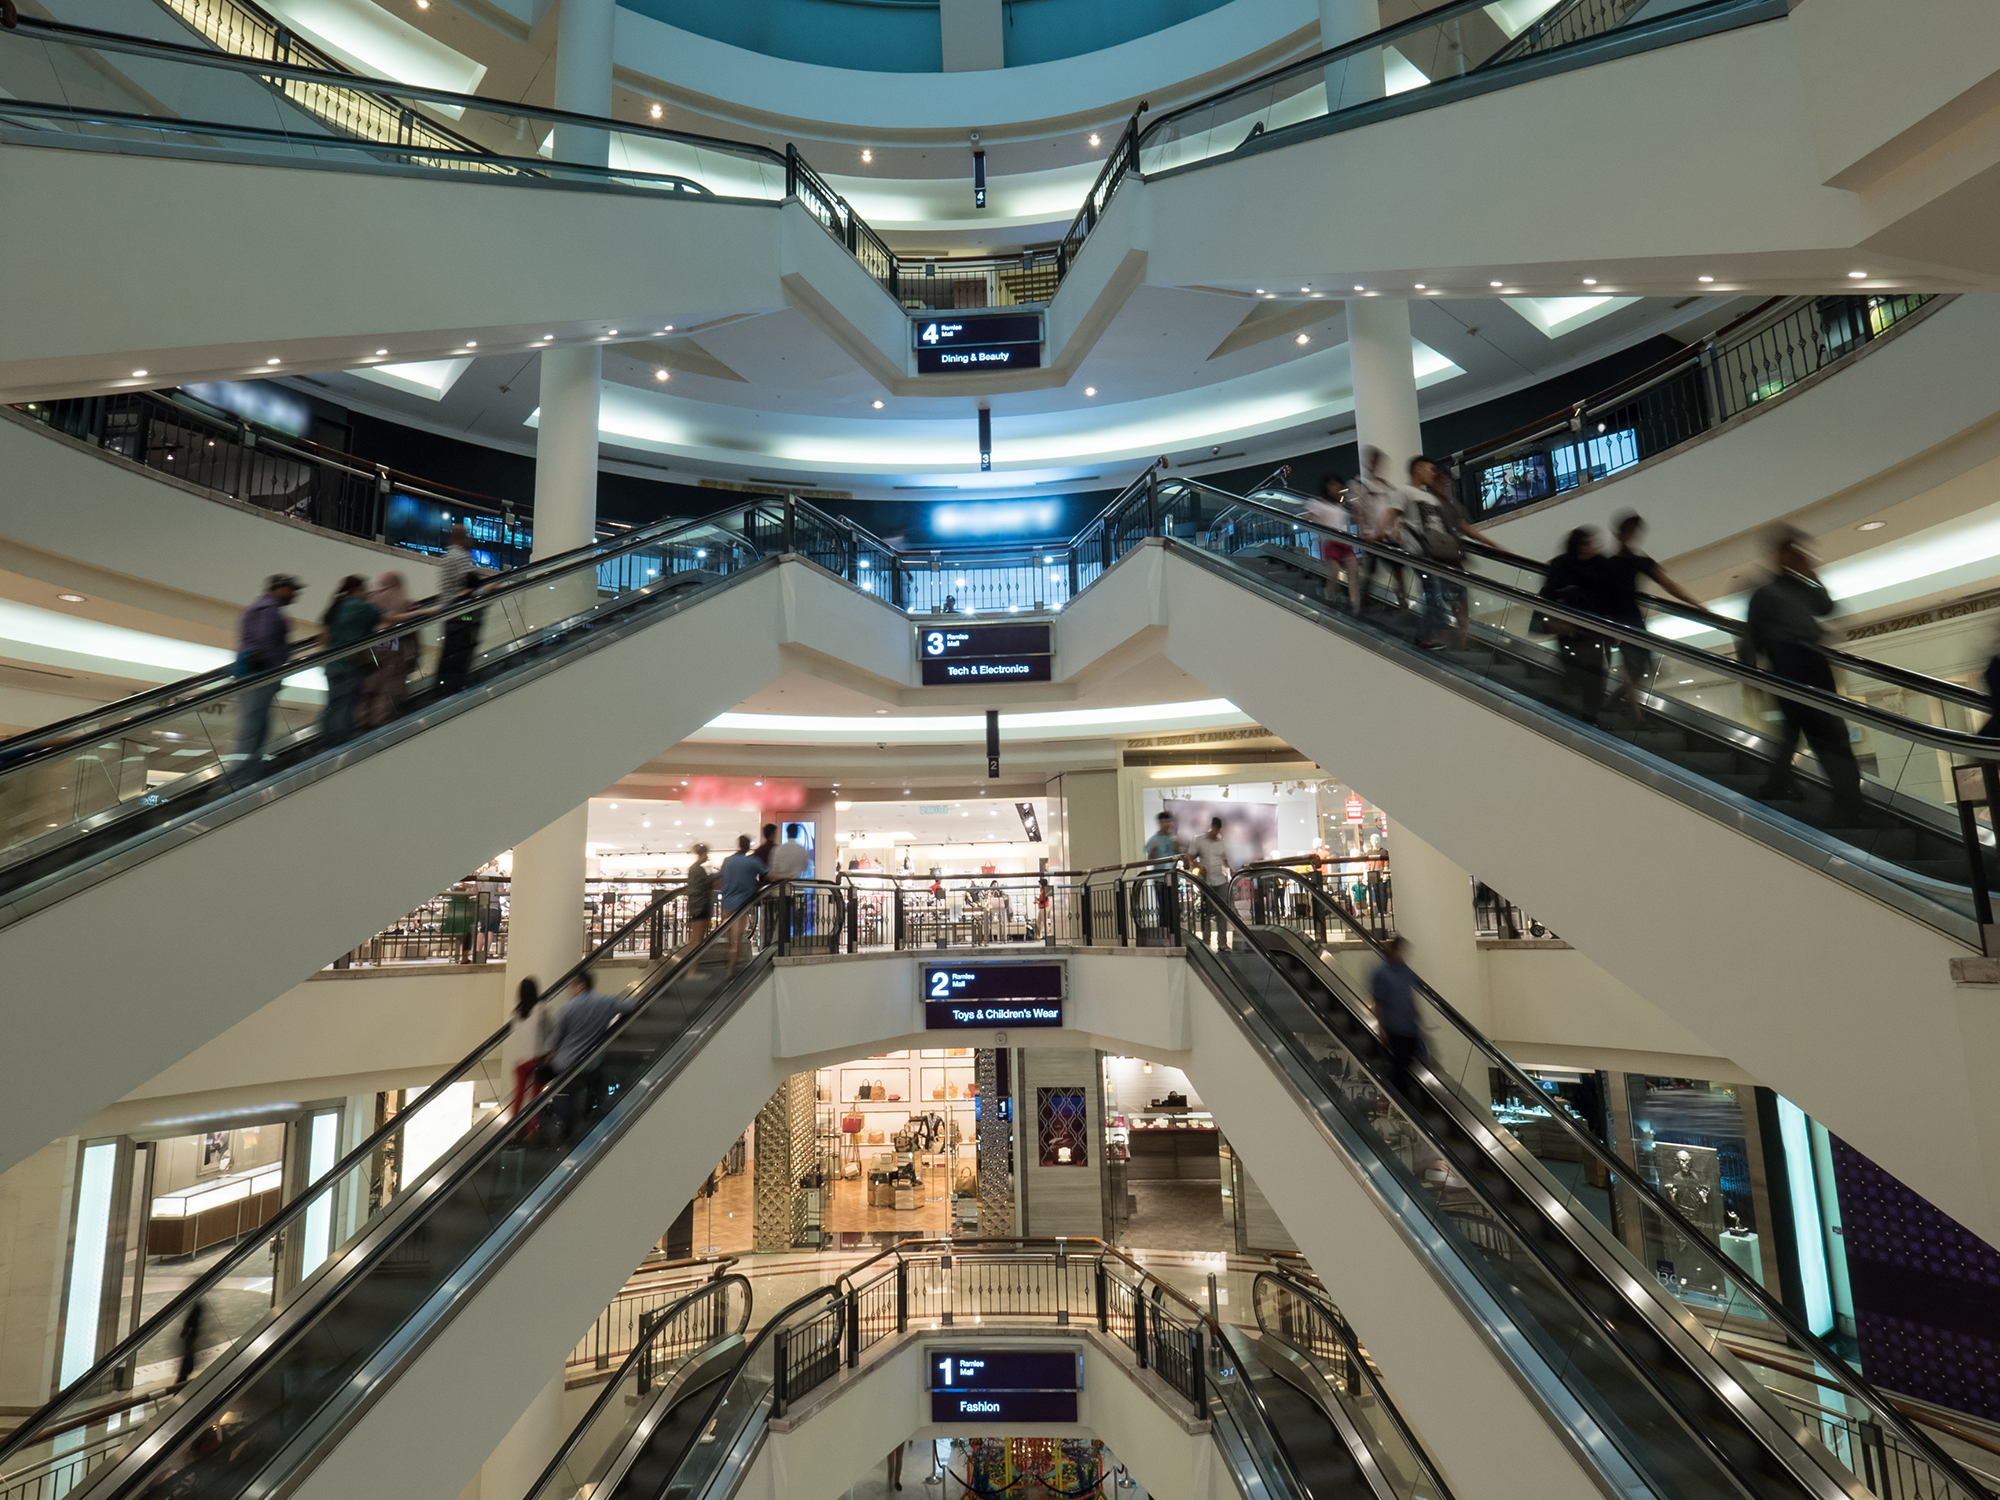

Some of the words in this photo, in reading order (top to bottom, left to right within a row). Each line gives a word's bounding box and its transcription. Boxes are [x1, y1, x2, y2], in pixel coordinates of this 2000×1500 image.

[977, 191, 984, 200] 4
[922, 323, 939, 344] 4
[941, 353, 969, 364] Dining
[970, 353, 977, 362] &
[979, 351, 1010, 362] Beauty
[982, 453, 990, 464] 3
[927, 632, 945, 655] 3
[947, 666, 969, 676] Tech
[970, 665, 978, 675] &
[979, 664, 1030, 675] Electronics
[990, 760, 998, 770] 2
[931, 971, 949, 997] 2
[952, 1009, 975, 1022] Toys
[976, 1009, 984, 1019] &
[985, 1008, 1032, 1020] Children's
[1033, 1008, 1059, 1019] Wear
[999, 1101, 1006, 1112] 1
[938, 1357, 952, 1385] 1
[960, 1400, 1000, 1412] Fashion
